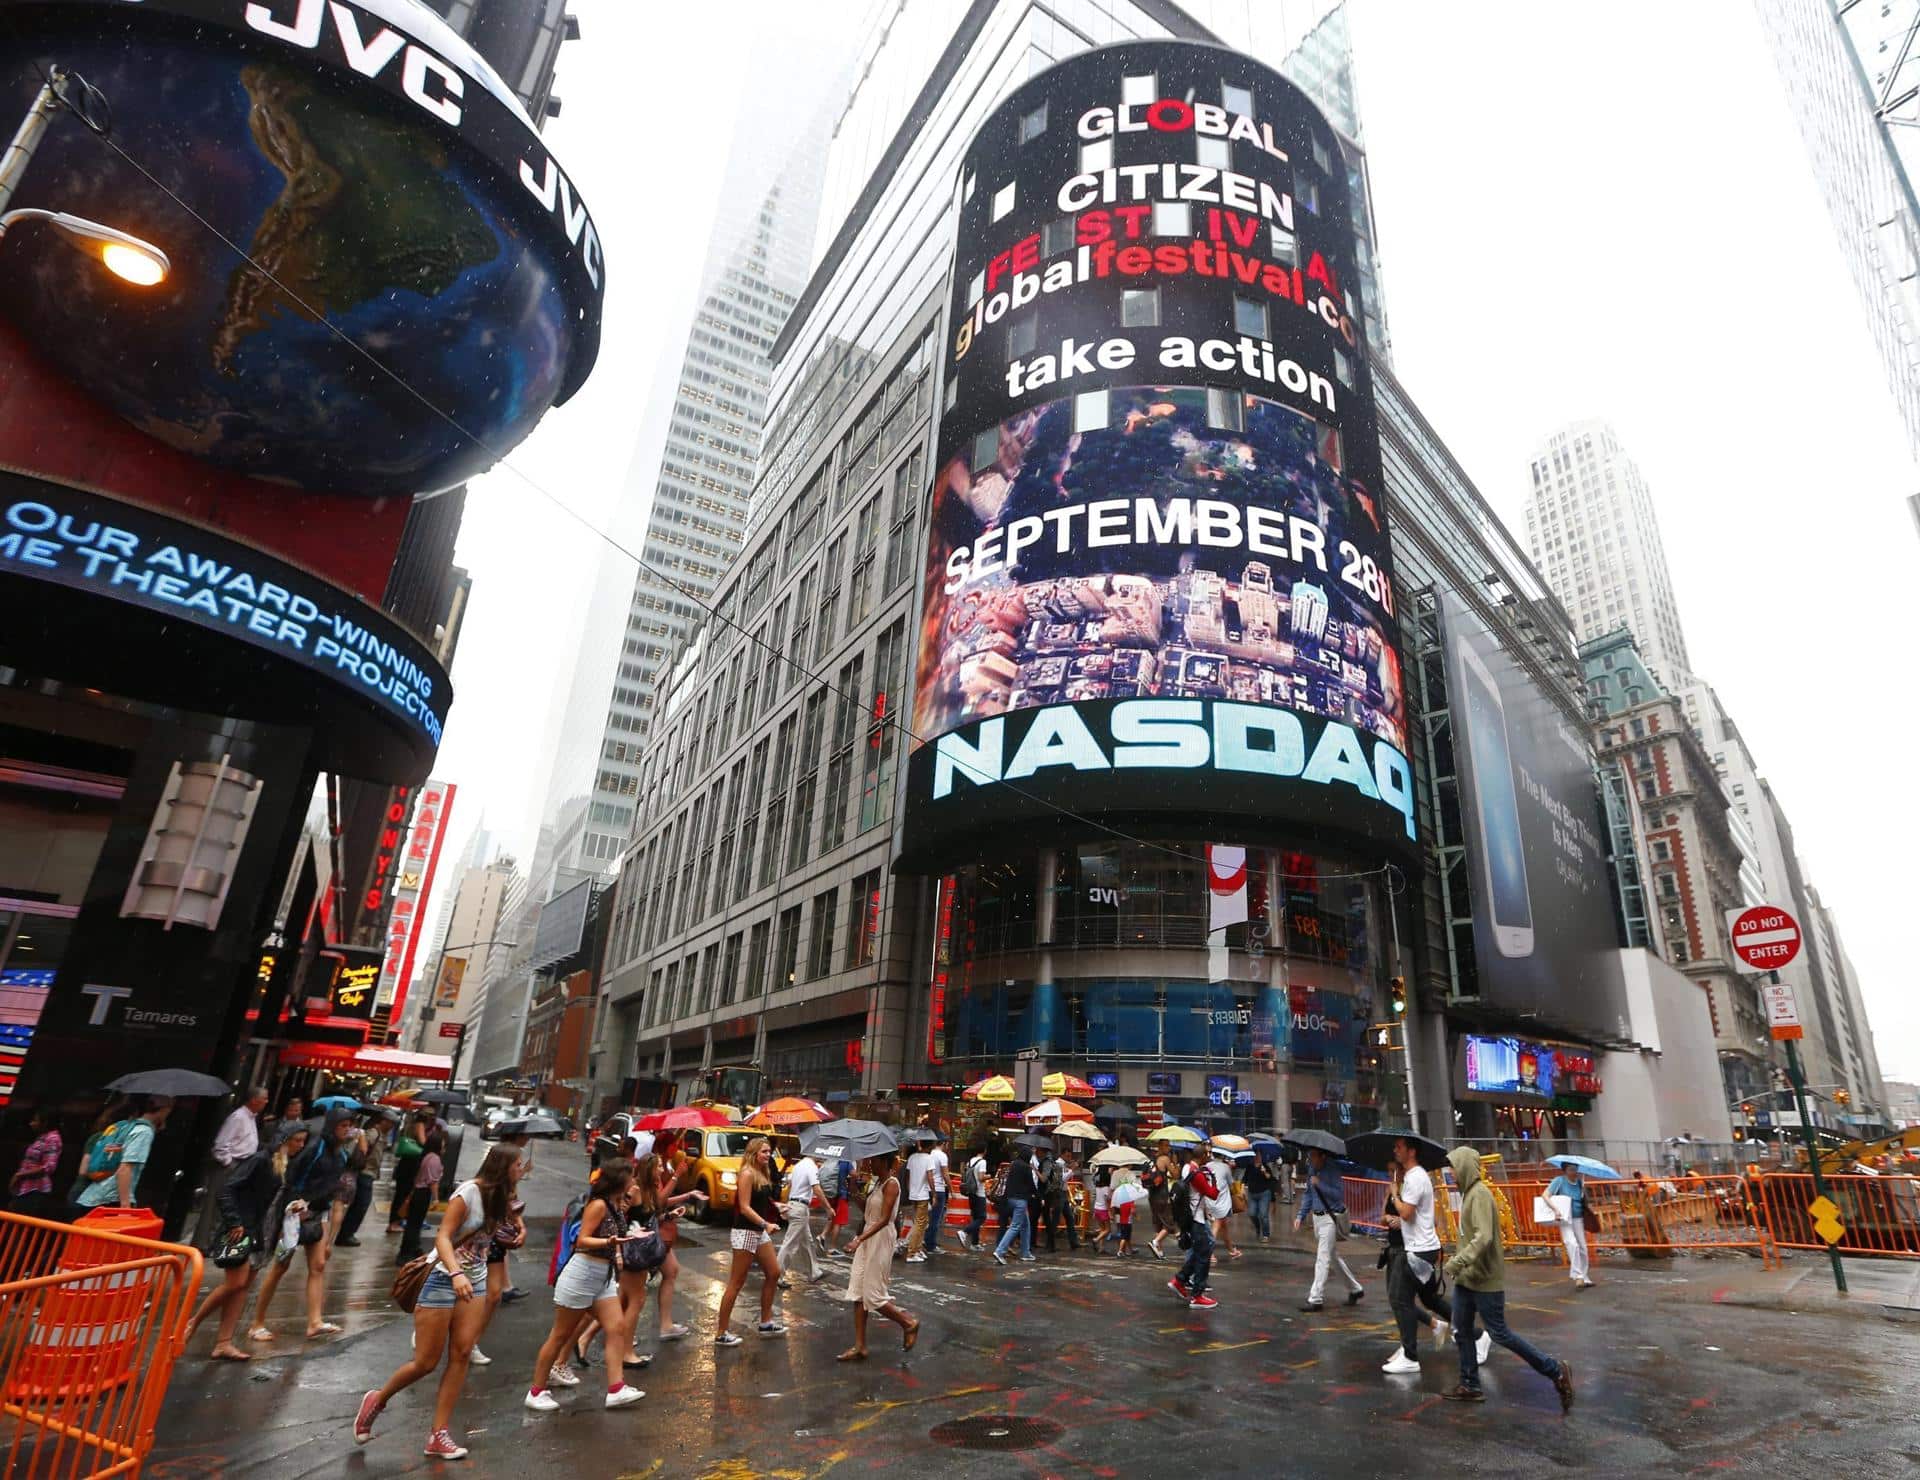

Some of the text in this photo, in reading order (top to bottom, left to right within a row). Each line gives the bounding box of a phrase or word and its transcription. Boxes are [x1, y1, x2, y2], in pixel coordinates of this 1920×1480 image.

[245, 0, 464, 126] JVC
[1077, 98, 1288, 162] GLOBAL
[519, 157, 602, 290] JVC
[1057, 163, 1294, 231] CITIZEN
[1005, 336, 1336, 413] take action
[944, 498, 1328, 596] SEPTEMBER
[6, 501, 432, 697] OUR AWARD-WINNING
[75, 546, 308, 648] THEATER
[314, 636, 441, 747] PROJECTORS
[932, 701, 1417, 843] NASDAQ
[1519, 764, 1540, 801] The
[1540, 784, 1563, 823] Next
[1562, 807, 1578, 839] Big
[364, 786, 408, 911] ONY'S
[1552, 820, 1583, 864] Is Here
[1740, 915, 1784, 932] DO NOT
[1749, 944, 1789, 960] ENTER
[123, 1007, 198, 1026] Tamares
